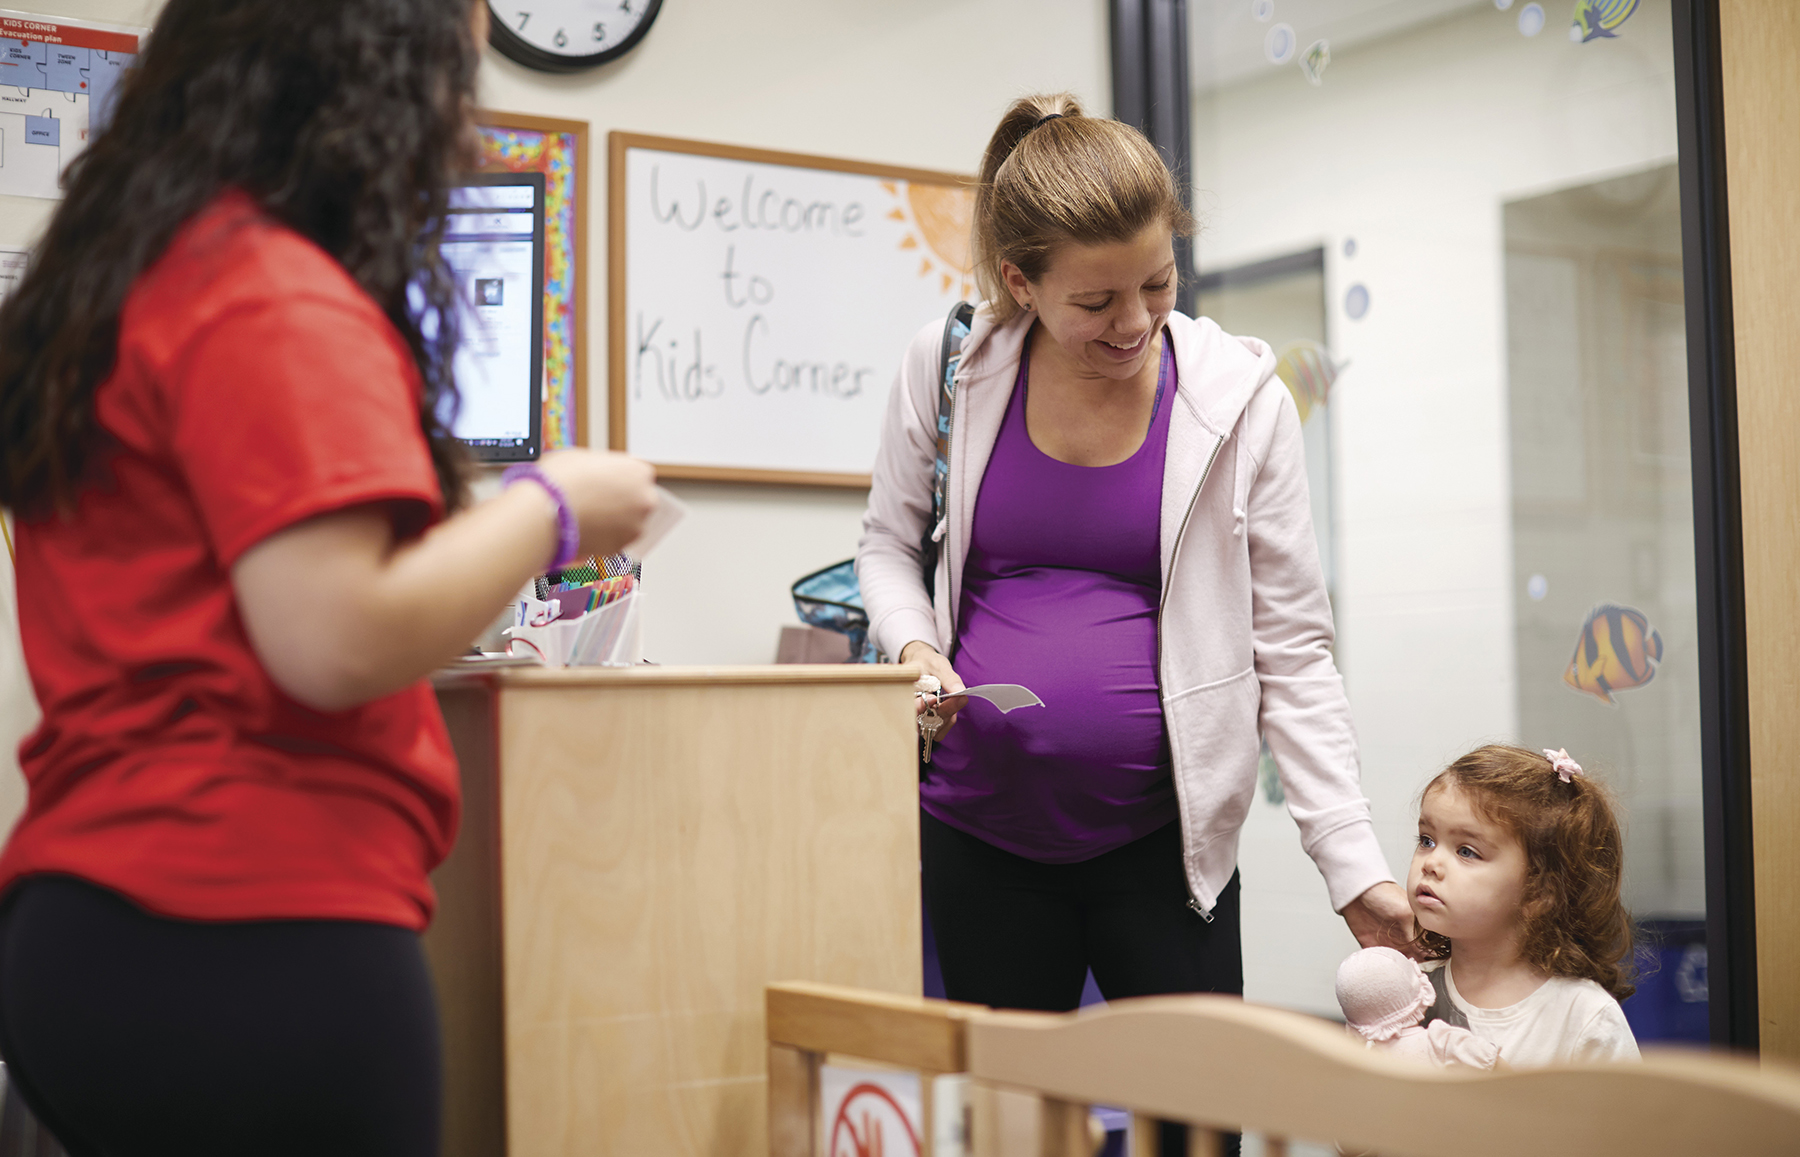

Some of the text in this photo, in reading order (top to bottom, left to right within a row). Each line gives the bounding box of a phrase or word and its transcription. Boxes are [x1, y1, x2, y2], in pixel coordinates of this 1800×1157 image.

[3, 19, 57, 32] KIDS CORNER
[517, 11, 531, 31] 7
[0, 28, 62, 43] Evacuation plan
[553, 28, 567, 47] 6
[592, 22, 605, 41] 5
[650, 163, 865, 237] Welcome
[720, 244, 774, 309] to
[635, 311, 874, 402] Kids Corner
